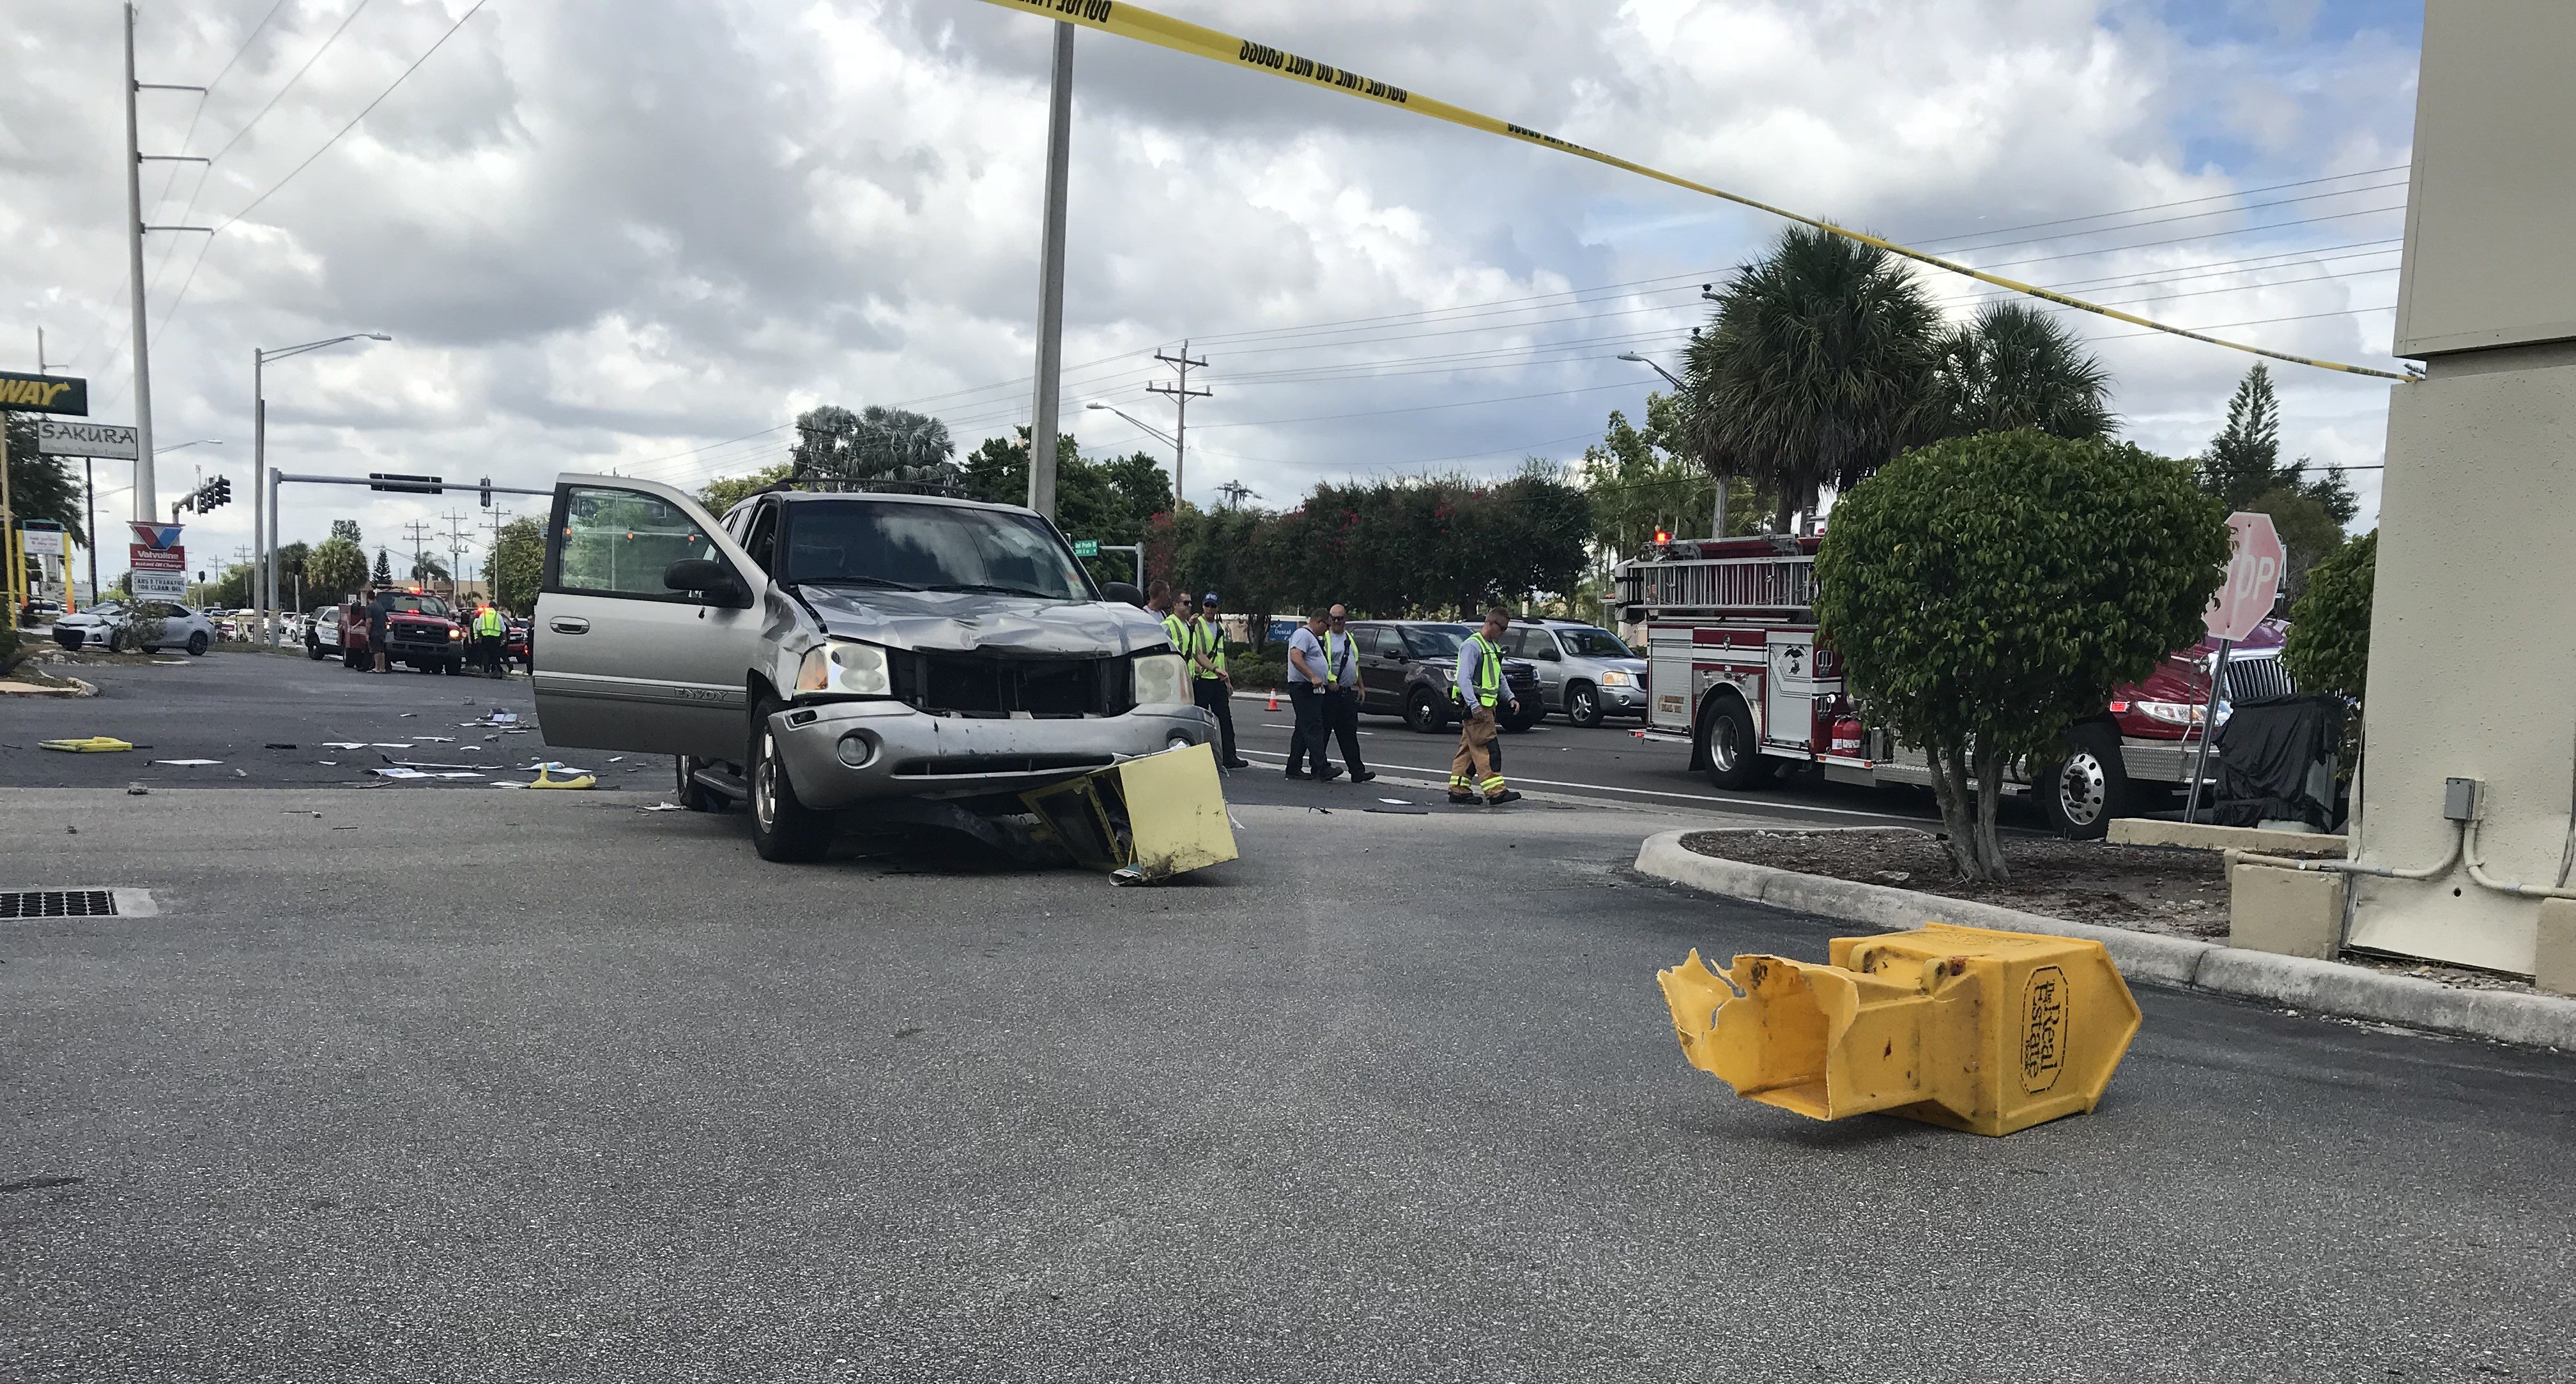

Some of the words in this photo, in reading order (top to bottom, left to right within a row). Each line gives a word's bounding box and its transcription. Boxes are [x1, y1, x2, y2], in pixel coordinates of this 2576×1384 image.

[40, 423, 135, 444] SAKURA
[137, 550, 179, 559] Valvoline
[2223, 553, 2275, 600] TOP
[675, 687, 728, 701] ENVOY
[2028, 982, 2048, 1078] Estate
[2040, 1002, 2060, 1073] Real
